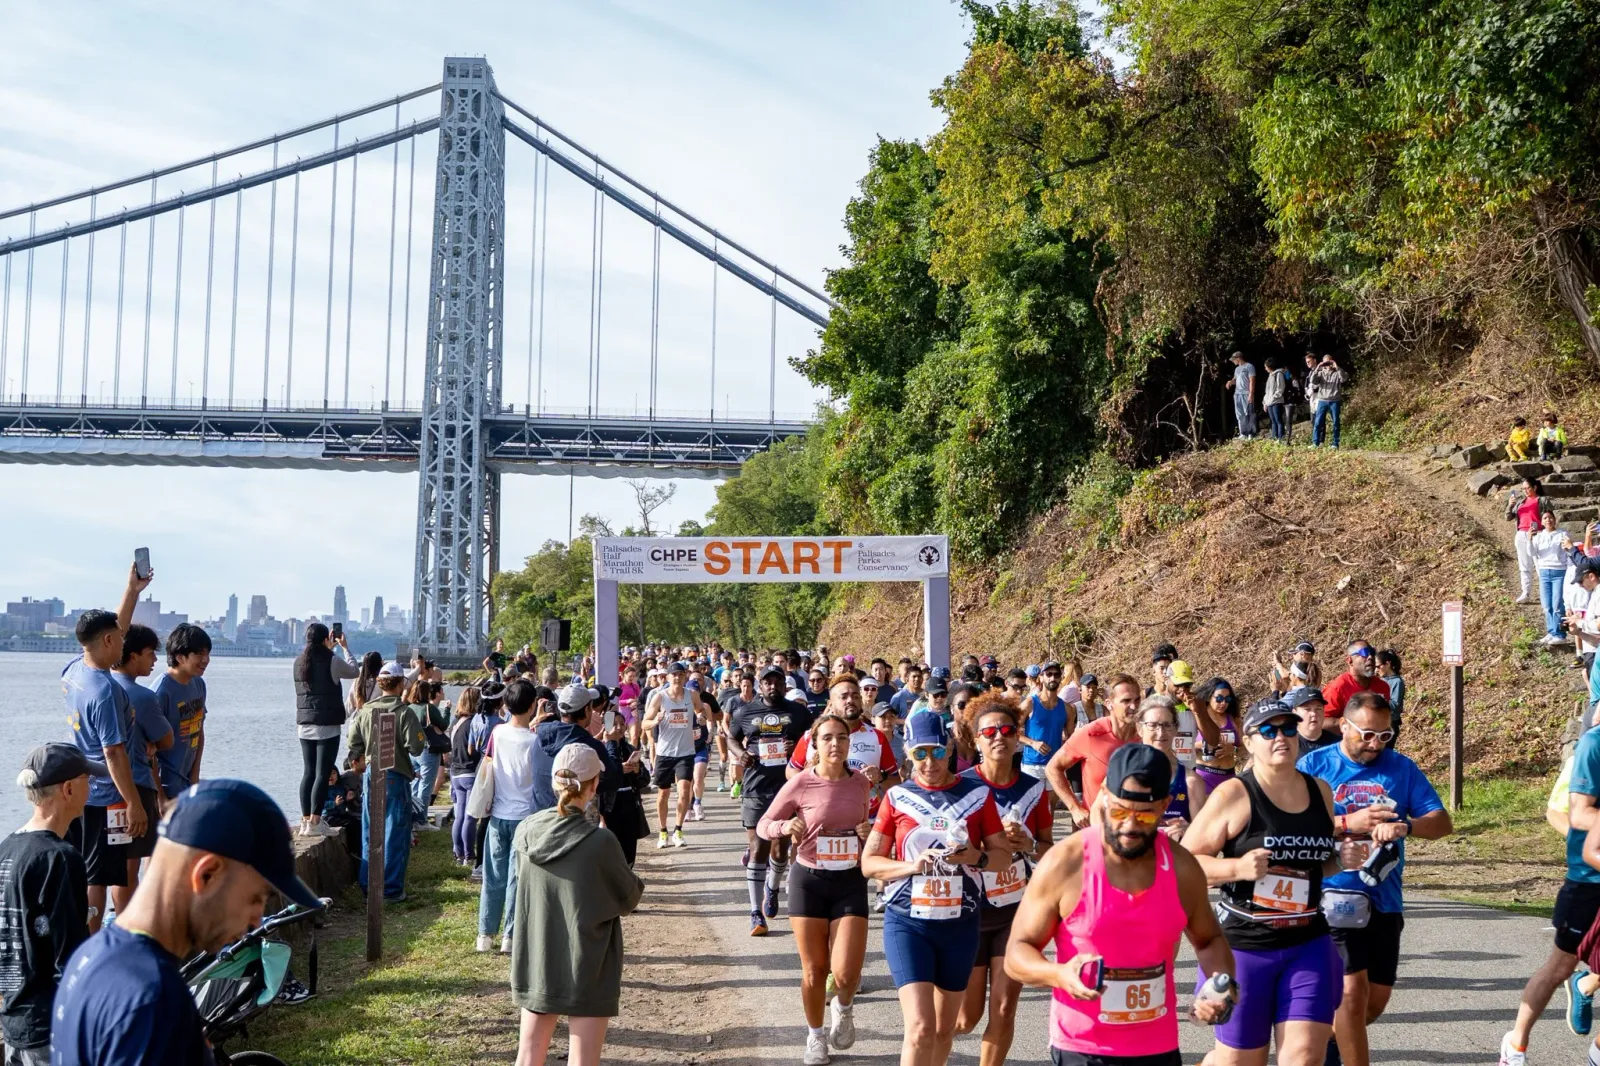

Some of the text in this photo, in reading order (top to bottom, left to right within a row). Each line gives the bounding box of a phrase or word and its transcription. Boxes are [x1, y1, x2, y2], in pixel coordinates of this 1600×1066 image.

[650, 549, 697, 562] CHPE
[703, 541, 853, 575] START
[857, 564, 910, 572] Conservancy
[767, 744, 778, 754] 86
[114, 811, 130, 827] 11
[827, 839, 848, 853] 111
[1263, 836, 1334, 848] DYCKMAN
[1267, 850, 1296, 860] RUN
[995, 865, 1020, 886] 402
[1272, 879, 1294, 900] 44
[1126, 984, 1151, 1009] 65
